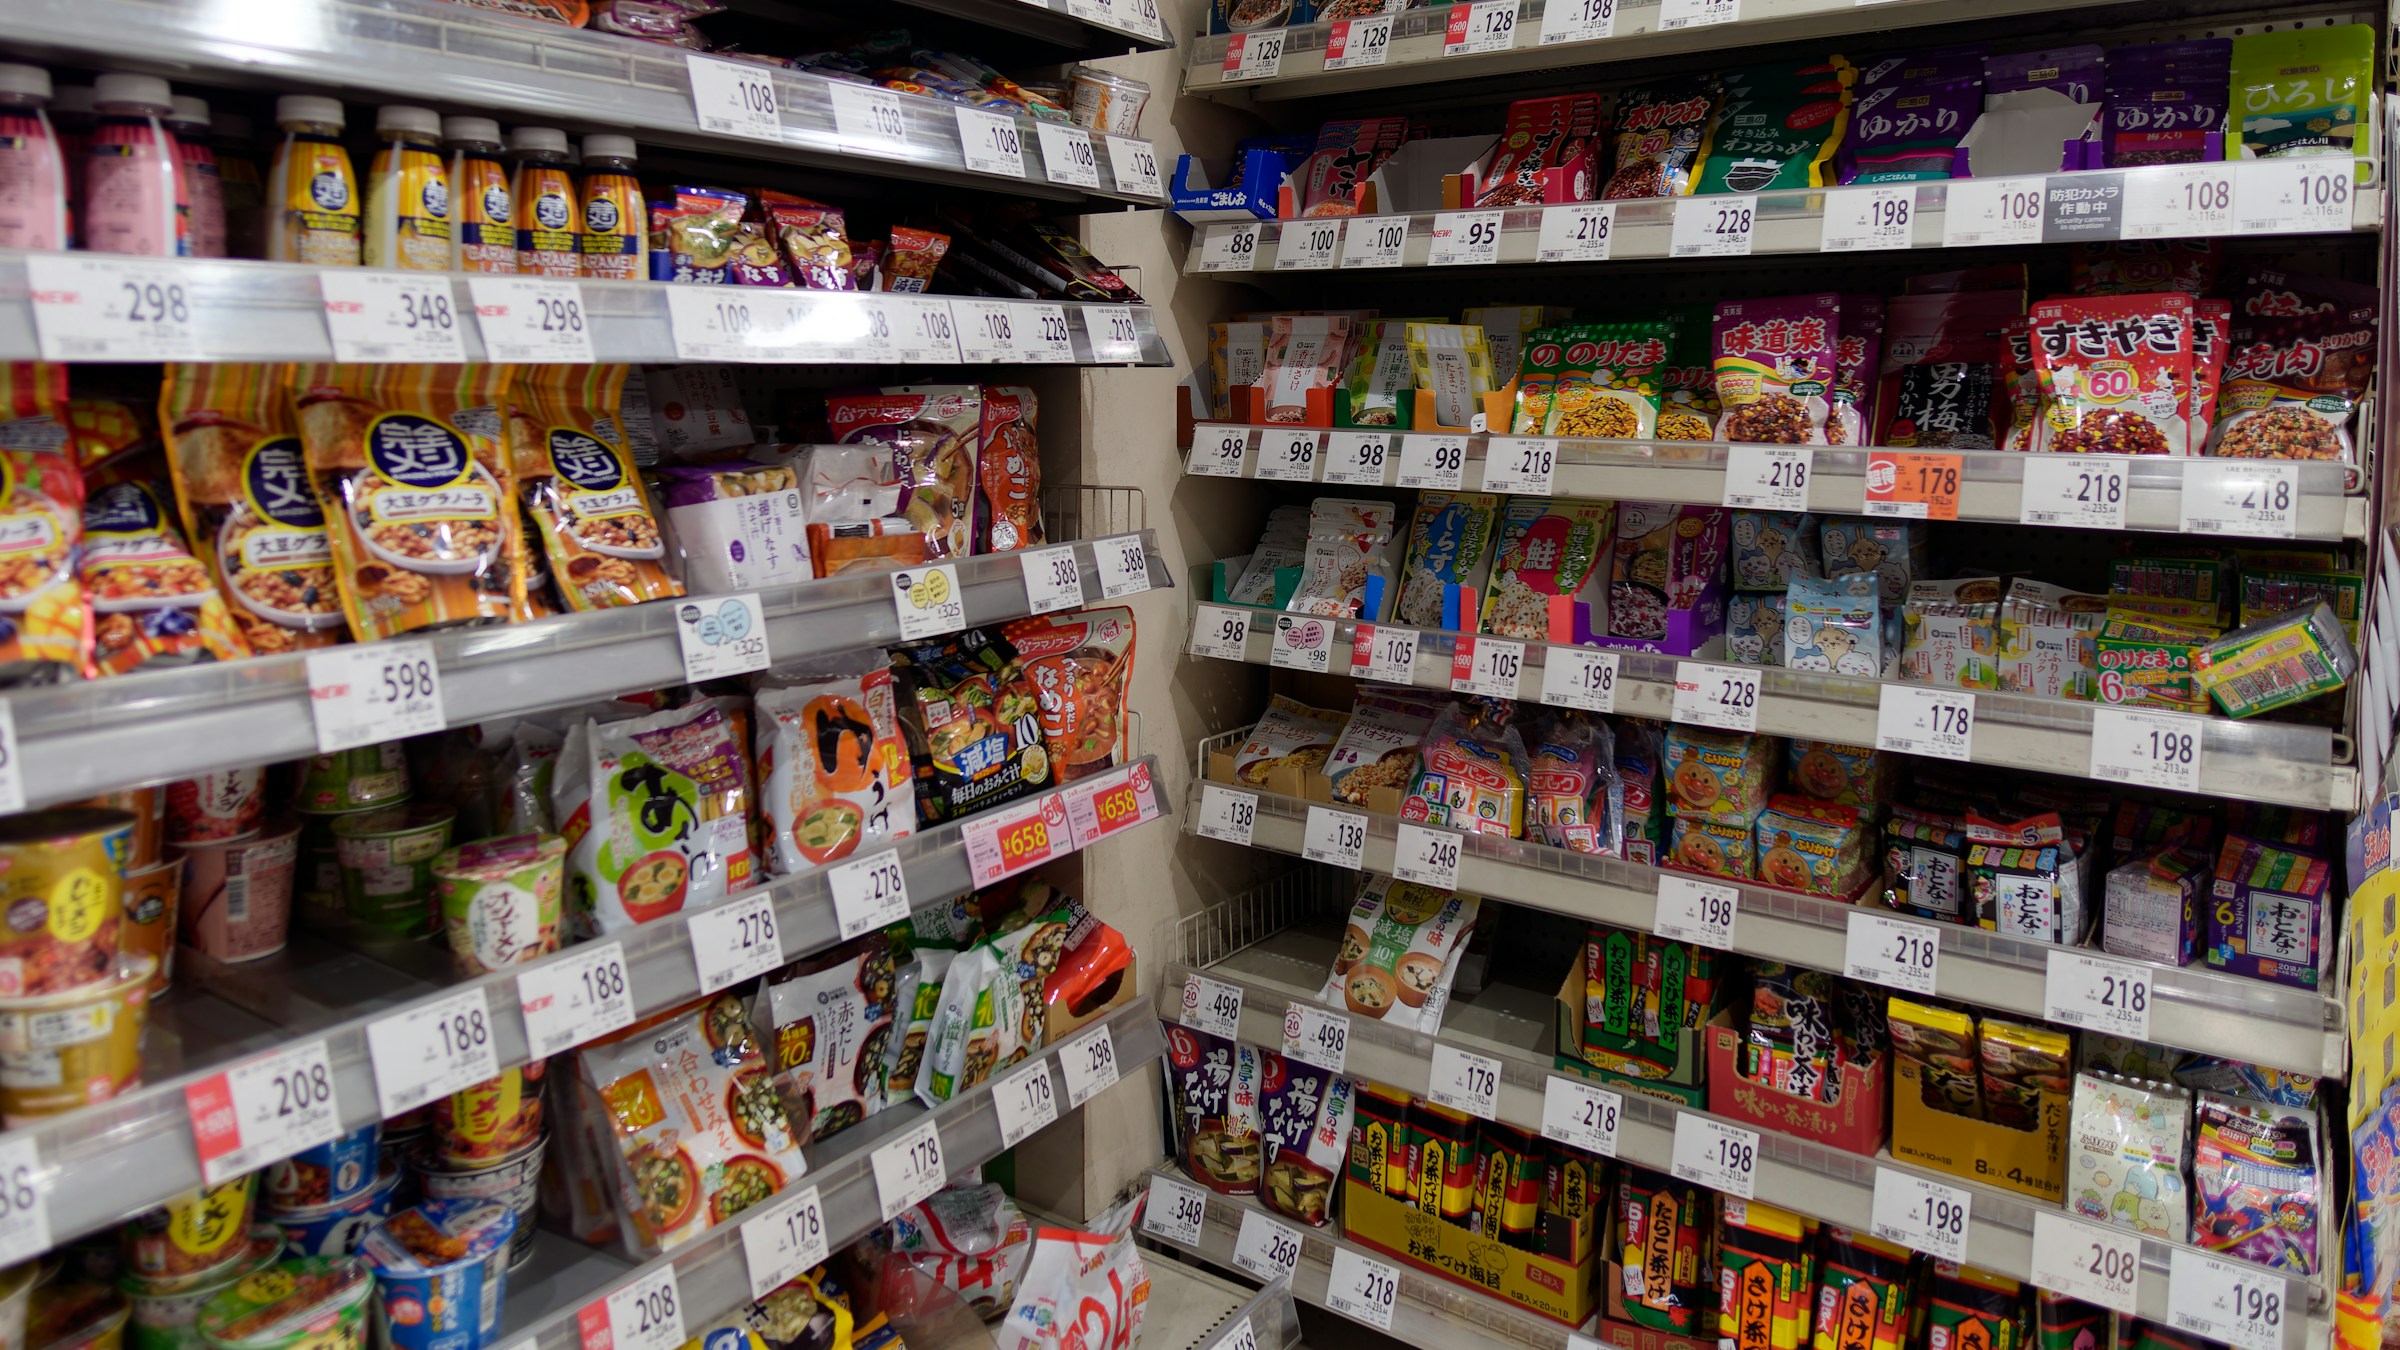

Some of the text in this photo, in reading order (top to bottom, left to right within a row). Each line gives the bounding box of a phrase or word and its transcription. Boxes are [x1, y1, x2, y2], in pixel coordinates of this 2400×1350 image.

[1486, 10, 1513, 33] 128
[1257, 40, 1281, 61] 128
[1363, 26, 1388, 48] 128
[739, 81, 774, 114] 108
[2245, 77, 2356, 112] ひろし
[1623, 97, 1710, 132] 本かつお
[1859, 108, 1959, 142] ゆかり
[2117, 104, 2216, 131] ゆかり
[992, 127, 1018, 154] 108
[1069, 141, 1093, 166] 108
[1722, 138, 1812, 155] わかめ
[1134, 153, 1156, 177] 128
[1211, 191, 1247, 207] ごましお
[2050, 187, 2119, 202] 防犯カメラ
[2185, 181, 2229, 210] 108
[2300, 174, 2347, 205] 108
[1873, 199, 1908, 226] 198
[2001, 192, 2040, 220] 108
[2053, 215, 2112, 225] Security camera
[2059, 201, 2108, 215] 作動中
[1432, 229, 1452, 238] NEW!
[1469, 222, 1496, 245] 95
[1577, 216, 1609, 240] 218
[1716, 209, 1751, 234] 228
[2068, 222, 2105, 231] operation
[1231, 233, 1254, 254] 88
[1310, 230, 1334, 251] 100
[1378, 226, 1403, 248] 100
[123, 282, 186, 323] 298
[401, 293, 452, 329] 348
[537, 298, 582, 332] 298
[2037, 308, 2063, 319] 丸美屋
[922, 312, 951, 339] 108
[985, 314, 1011, 339] 108
[1042, 317, 1067, 341] 228
[1111, 318, 1135, 341] 218
[1722, 317, 1827, 357] 味道楽
[2038, 315, 2184, 358] すきやき
[2317, 329, 2371, 350] ふりかけ
[1565, 338, 1667, 368] のりたま
[2222, 341, 2325, 382] 焼肉
[1445, 362, 1461, 424] たまごとのり
[2087, 369, 2129, 397] 60
[1915, 361, 1967, 434] 男梅
[1221, 438, 1243, 459] 98
[1289, 441, 1313, 463] 98
[1359, 444, 1384, 466] 98
[1435, 447, 1461, 470] 98
[1521, 450, 1551, 474] 218
[1770, 461, 1805, 488] 218
[1919, 467, 1956, 495] 178
[2077, 473, 2121, 503] 218
[1429, 508, 1455, 573] しらす
[1523, 537, 1554, 571] 鮭
[1052, 559, 1077, 586] 388
[1122, 547, 1144, 573] 388
[1031, 635, 1081, 650] アマノフーズ
[1222, 620, 1244, 642] 98
[1388, 640, 1413, 664] 105
[1932, 635, 1944, 662] パック
[1943, 641, 1956, 682] ふりかけ
[1492, 653, 1518, 678] 105
[2124, 668, 2193, 685] バラエティー
[384, 660, 433, 703] 598
[1720, 680, 1754, 708] 228
[2100, 669, 2125, 703] 6
[1035, 665, 1064, 737] なめこ
[1013, 713, 1039, 750] 10
[1258, 725, 1315, 743] カレーピラフ
[1353, 718, 1409, 736] ごはんとまぜるだけ
[1932, 705, 1968, 735] 178
[1348, 724, 1403, 746] ガパオライス
[2150, 731, 2193, 764] 198
[961, 737, 1006, 776] 減塩
[1702, 751, 1744, 769] ふりかけ
[951, 763, 1021, 804] 毎日のおみそ汁
[1433, 756, 1502, 786] ミニパック
[1098, 789, 1136, 818] ¥658
[1231, 802, 1253, 826] 138
[1002, 823, 1048, 852] ¥658
[1339, 824, 1363, 849] 138
[1707, 824, 1747, 840] ふりかけ
[2020, 826, 2040, 846] 5
[1428, 842, 1457, 868] 248
[1795, 839, 1839, 858] ふりかけ
[870, 864, 901, 899] 278
[1925, 855, 1951, 906] おとなの
[1700, 896, 1731, 926] 198
[2015, 883, 2042, 936] おとなの
[738, 909, 774, 948] 278
[1372, 918, 1412, 948] 減塩
[2269, 901, 2299, 955] おとなの
[1895, 935, 1934, 968] 218
[1214, 994, 1238, 1020] 498
[2101, 976, 2145, 1012] 218
[439, 1009, 487, 1056] 188
[838, 1000, 853, 1067] 赤だし
[1172, 1028, 1193, 1056] 6
[1318, 1024, 1345, 1052] 498
[1088, 1039, 1111, 1071] 298
[273, 1063, 330, 1117] 208
[1025, 1074, 1050, 1107] 178
[1234, 1045, 1255, 1108] 料亭の味
[1468, 1067, 1494, 1096] 178
[1318, 1076, 1352, 1149] 料亭の味
[1583, 1100, 1616, 1132] 218
[1732, 1087, 1838, 1134] 味わい茶漬け
[910, 1137, 938, 1174] 178
[787, 1205, 819, 1246] 178
[1407, 1237, 1501, 1290] お茶づけ海苔
[1647, 1200, 1672, 1300] たらこ茶づけ
[1528, 1266, 1559, 1290] 8袋入
[636, 1284, 675, 1333] 208
